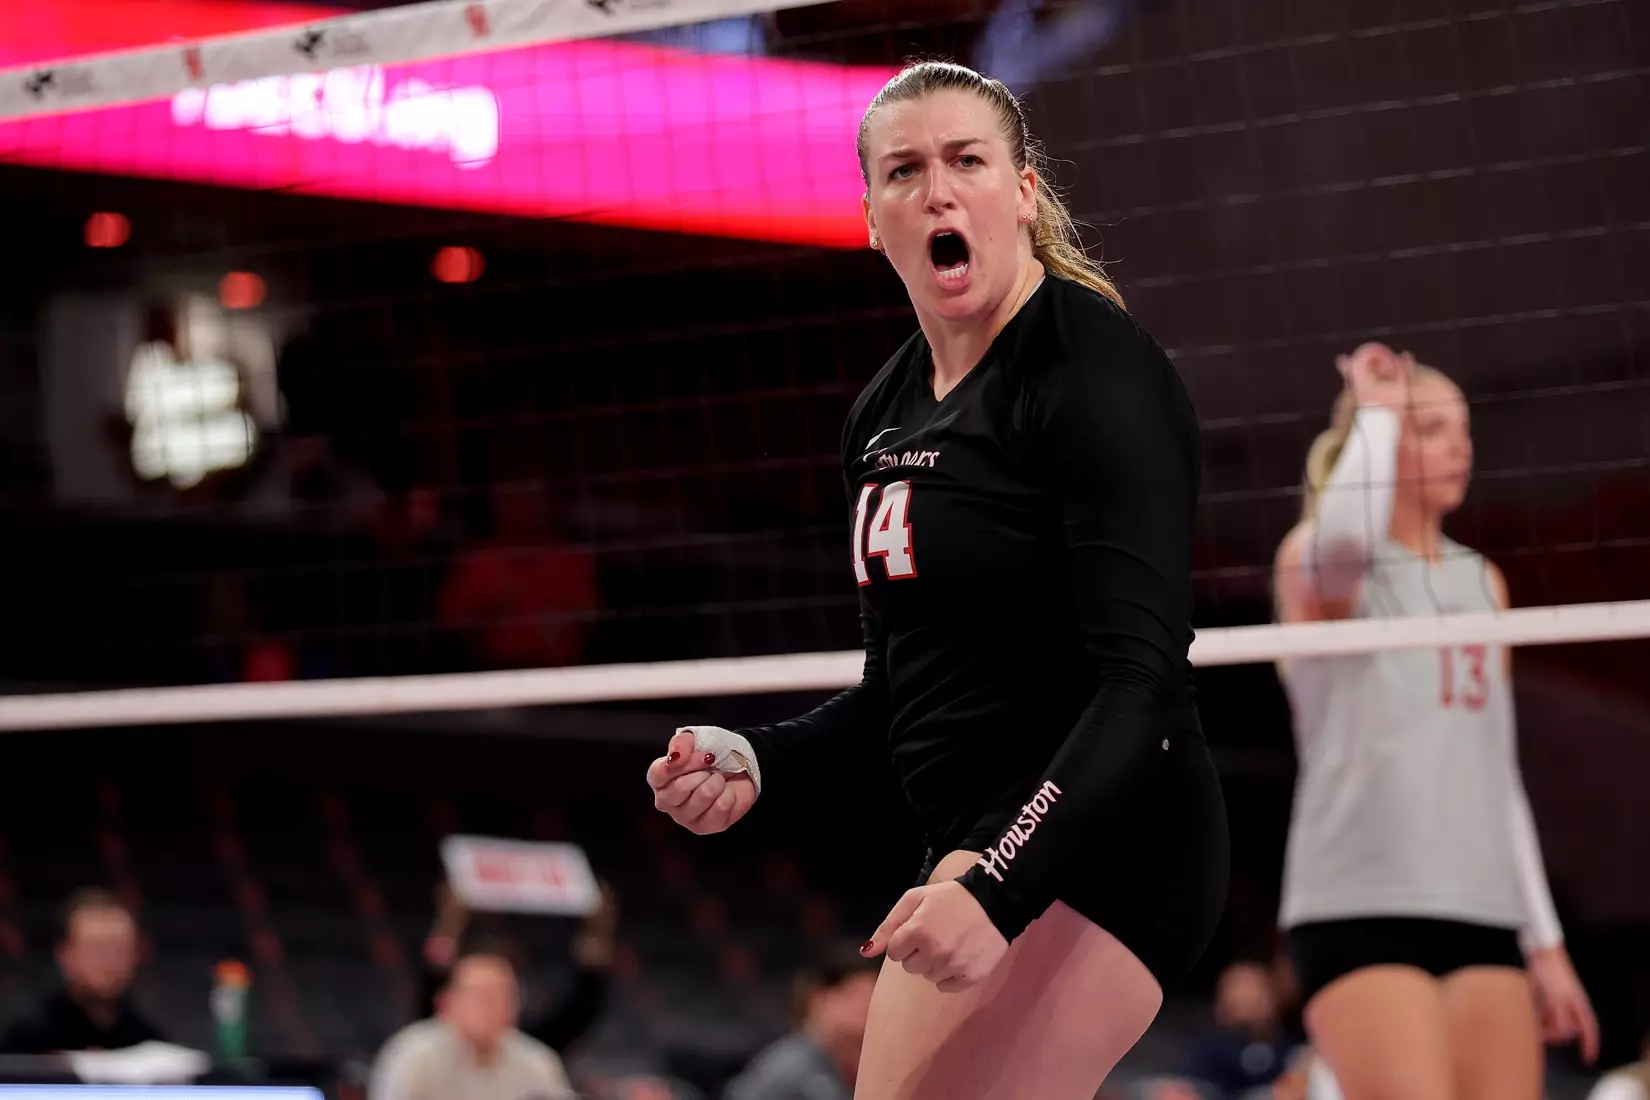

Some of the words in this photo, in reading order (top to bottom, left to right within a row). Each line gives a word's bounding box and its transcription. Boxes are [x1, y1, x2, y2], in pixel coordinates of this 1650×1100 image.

[852, 480, 918, 587] 14
[1437, 643, 1491, 712] 13
[977, 780, 1062, 882] Houston
